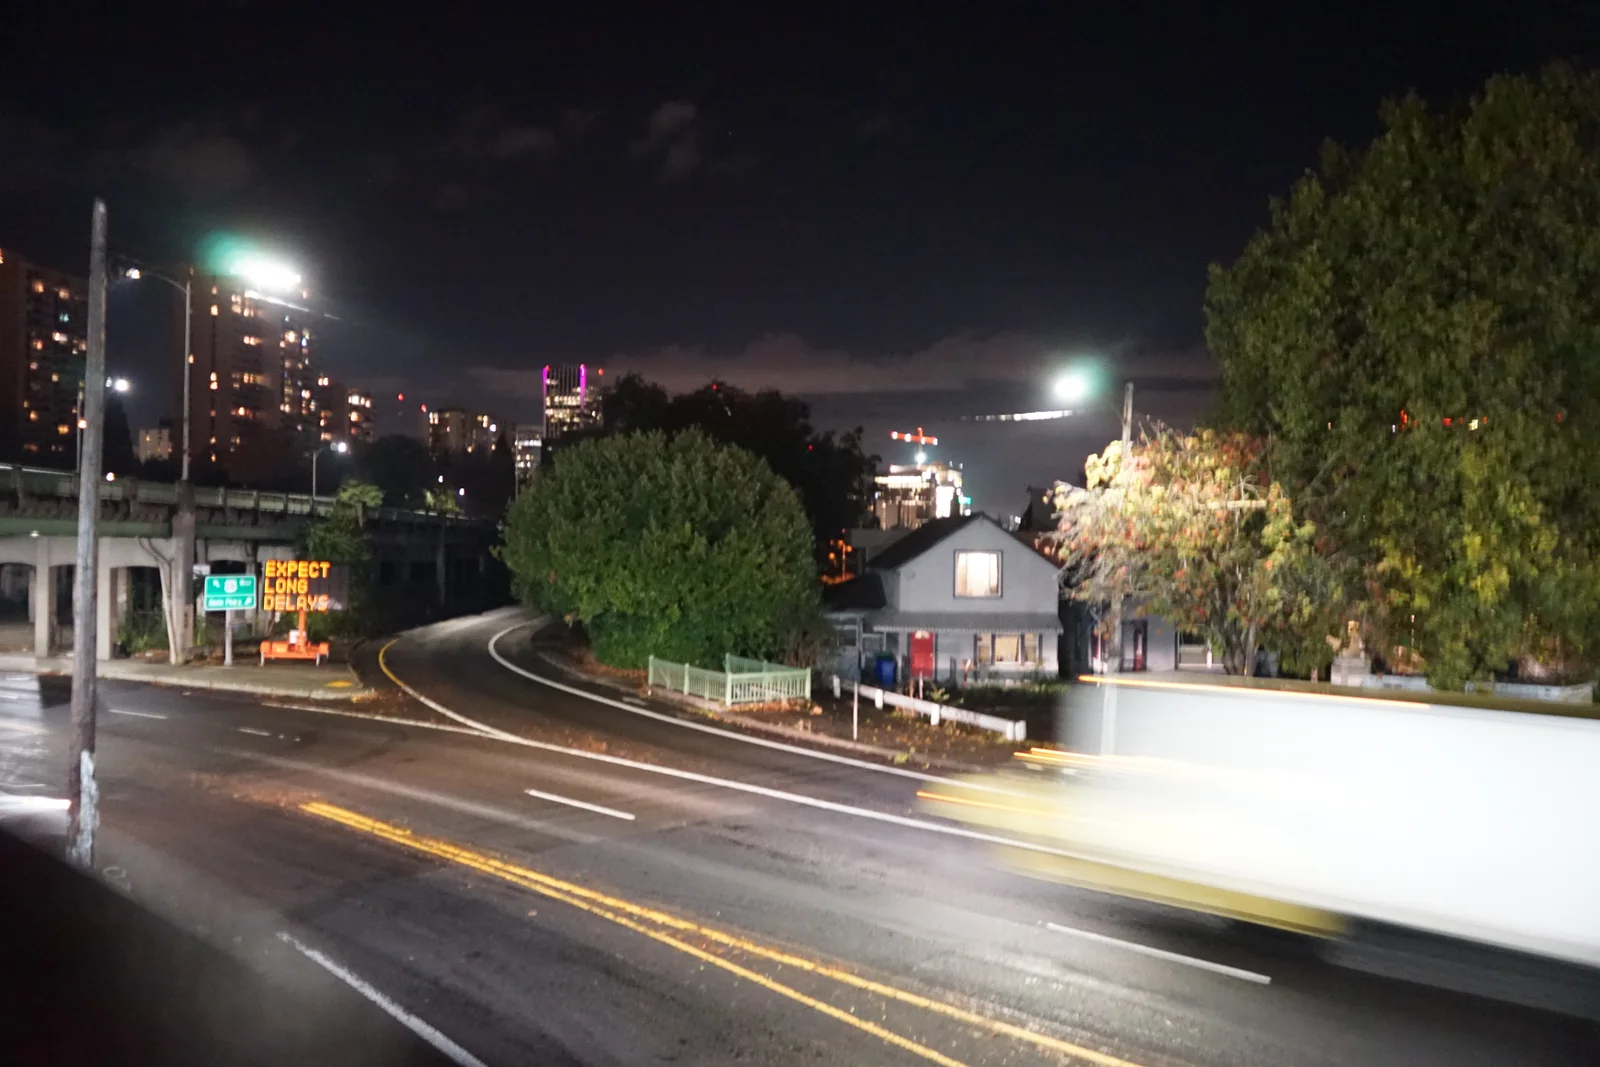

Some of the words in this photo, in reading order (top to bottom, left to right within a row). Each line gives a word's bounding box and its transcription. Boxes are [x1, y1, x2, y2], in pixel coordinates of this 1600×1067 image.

[265, 560, 331, 579] EXPECT
[264, 577, 308, 594] LONG
[263, 594, 329, 613] DELAYS
